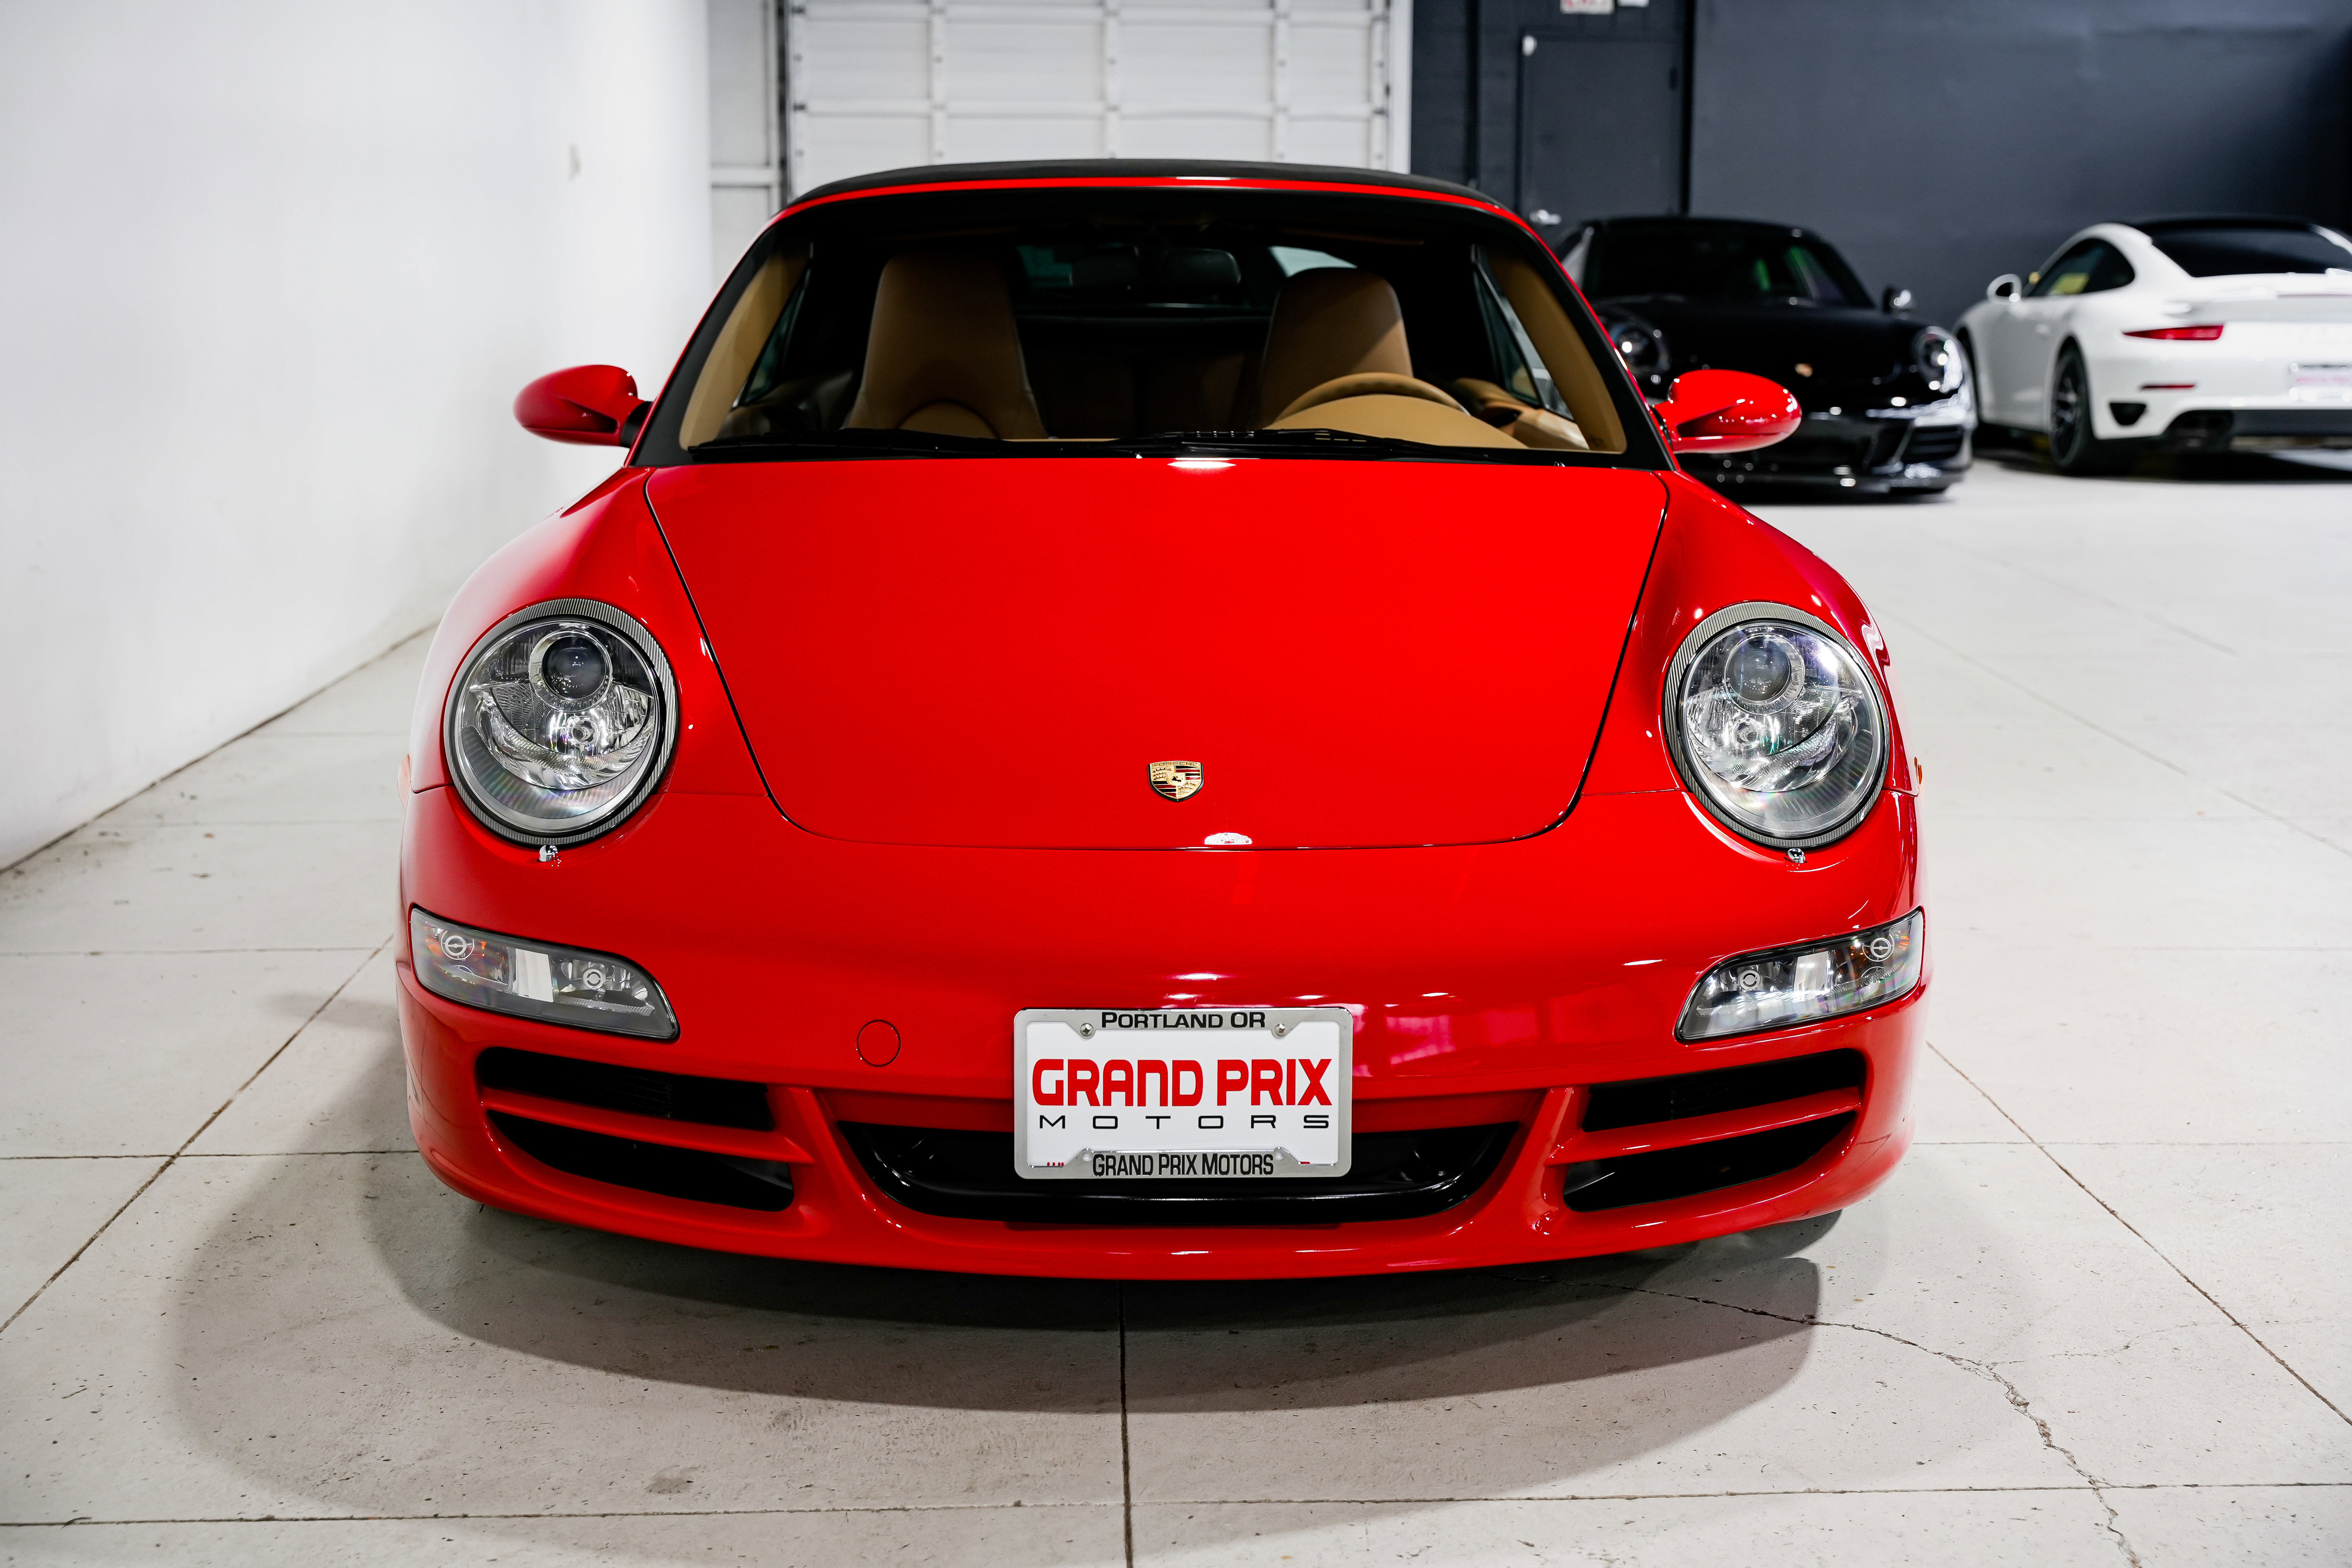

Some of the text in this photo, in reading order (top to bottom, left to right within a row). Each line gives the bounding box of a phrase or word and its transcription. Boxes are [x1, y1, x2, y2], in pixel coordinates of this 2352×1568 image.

[1102, 1012, 1265, 1028] PORTLAND OR
[1033, 1059, 1332, 1107] GRAND PRIX
[1040, 1115, 1329, 1129] MOTORS
[1093, 1154, 1273, 1176] GRAND PRIX MOTORS
